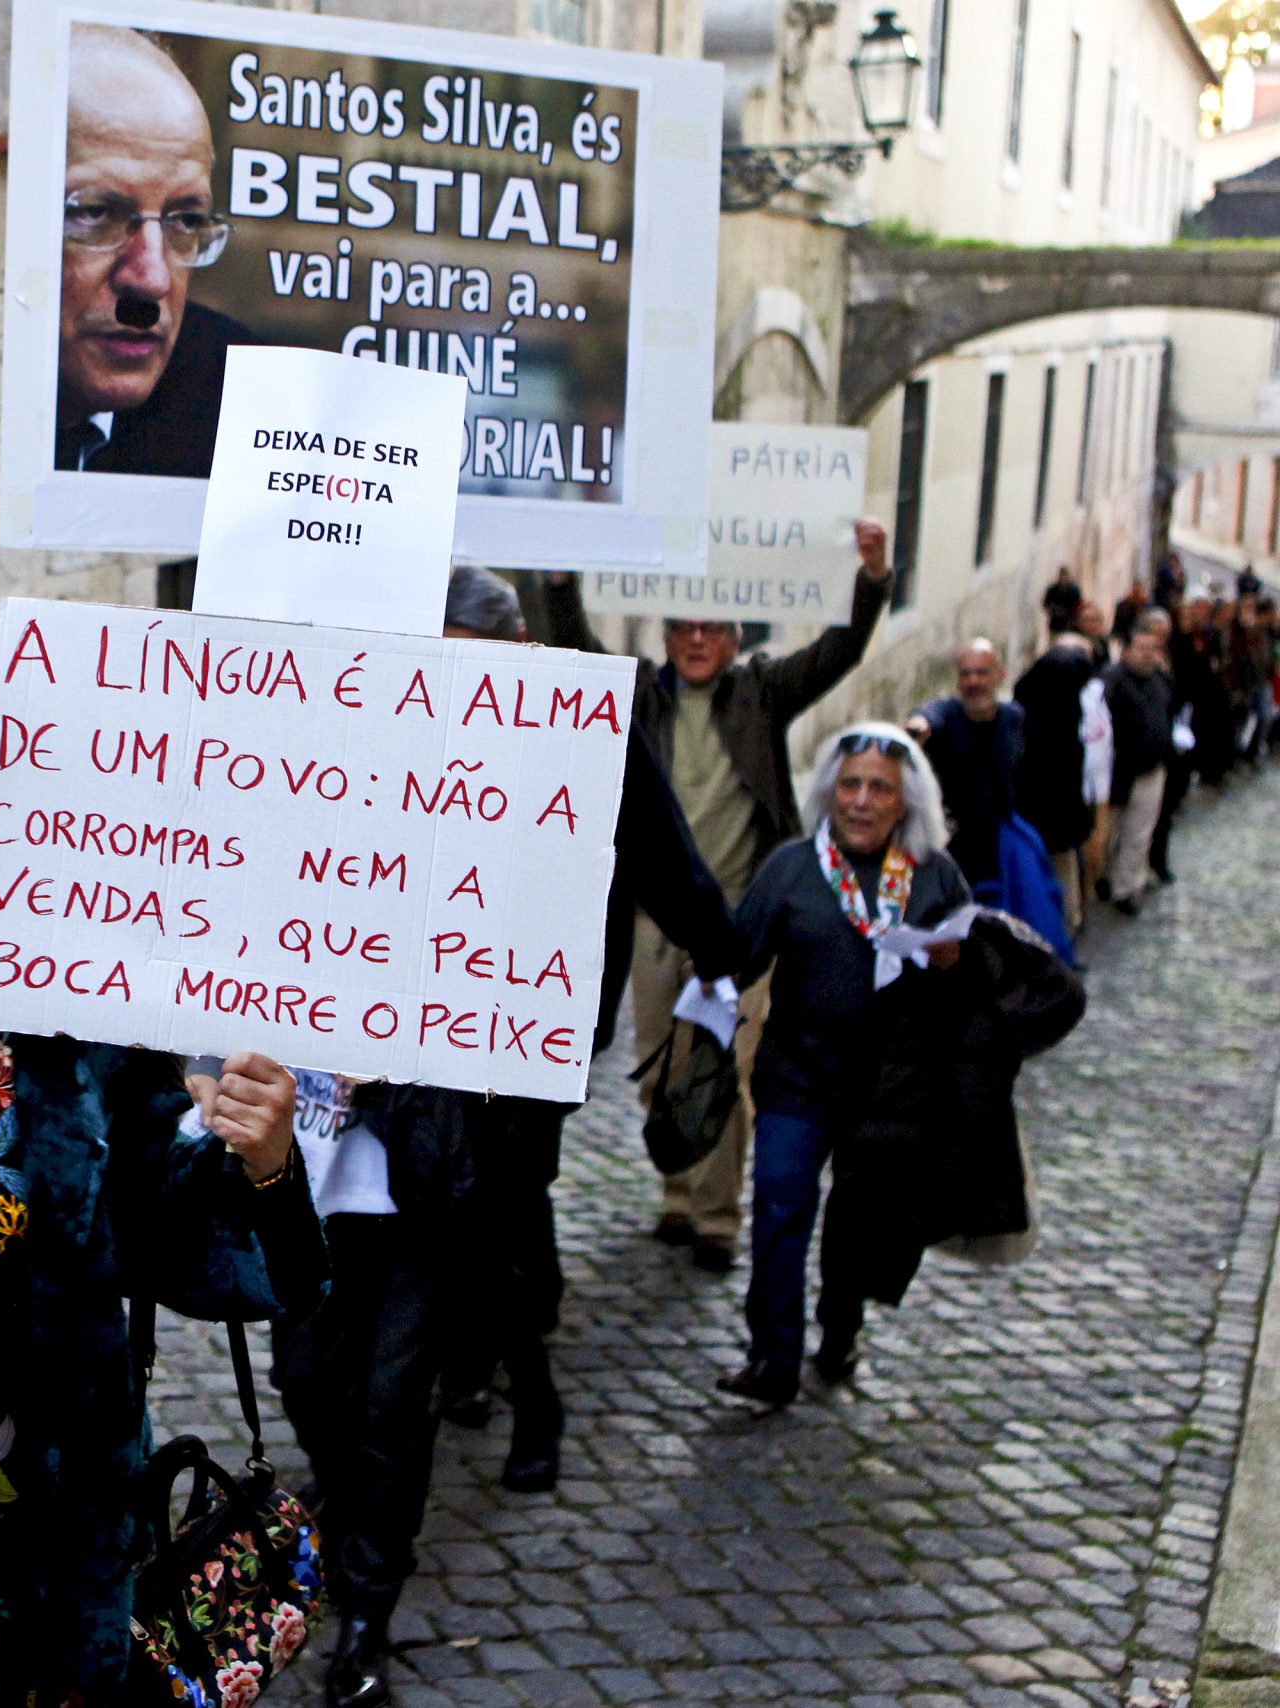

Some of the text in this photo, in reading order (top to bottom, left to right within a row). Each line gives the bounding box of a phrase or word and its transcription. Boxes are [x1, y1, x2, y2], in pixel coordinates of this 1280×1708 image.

[228, 52, 621, 165] Santos Silva, és
[229, 147, 619, 264] BESTIAL,
[267, 237, 588, 323] vai para a...
[253, 428, 419, 467] DEIXA DE SER
[464, 416, 614, 485] RIAL!
[730, 442, 853, 481] PÁTRIA
[267, 470, 394, 504] ESPE(C)TA
[287, 518, 362, 546] DOR!!
[597, 572, 824, 606] PORTUGUESA
[5, 618, 622, 734] A LÍNGUA É A ALMA
[91, 729, 169, 786] UM
[402, 760, 508, 822] NÃO
[536, 784, 578, 834] A
[299, 847, 407, 893] NEM
[448, 866, 485, 909] A
[279, 919, 391, 966] QUE
[430, 931, 573, 997] PELA
[175, 967, 337, 1034] MORRE
[362, 1002, 398, 1040] O
[419, 1002, 583, 1067] PEIXE.
